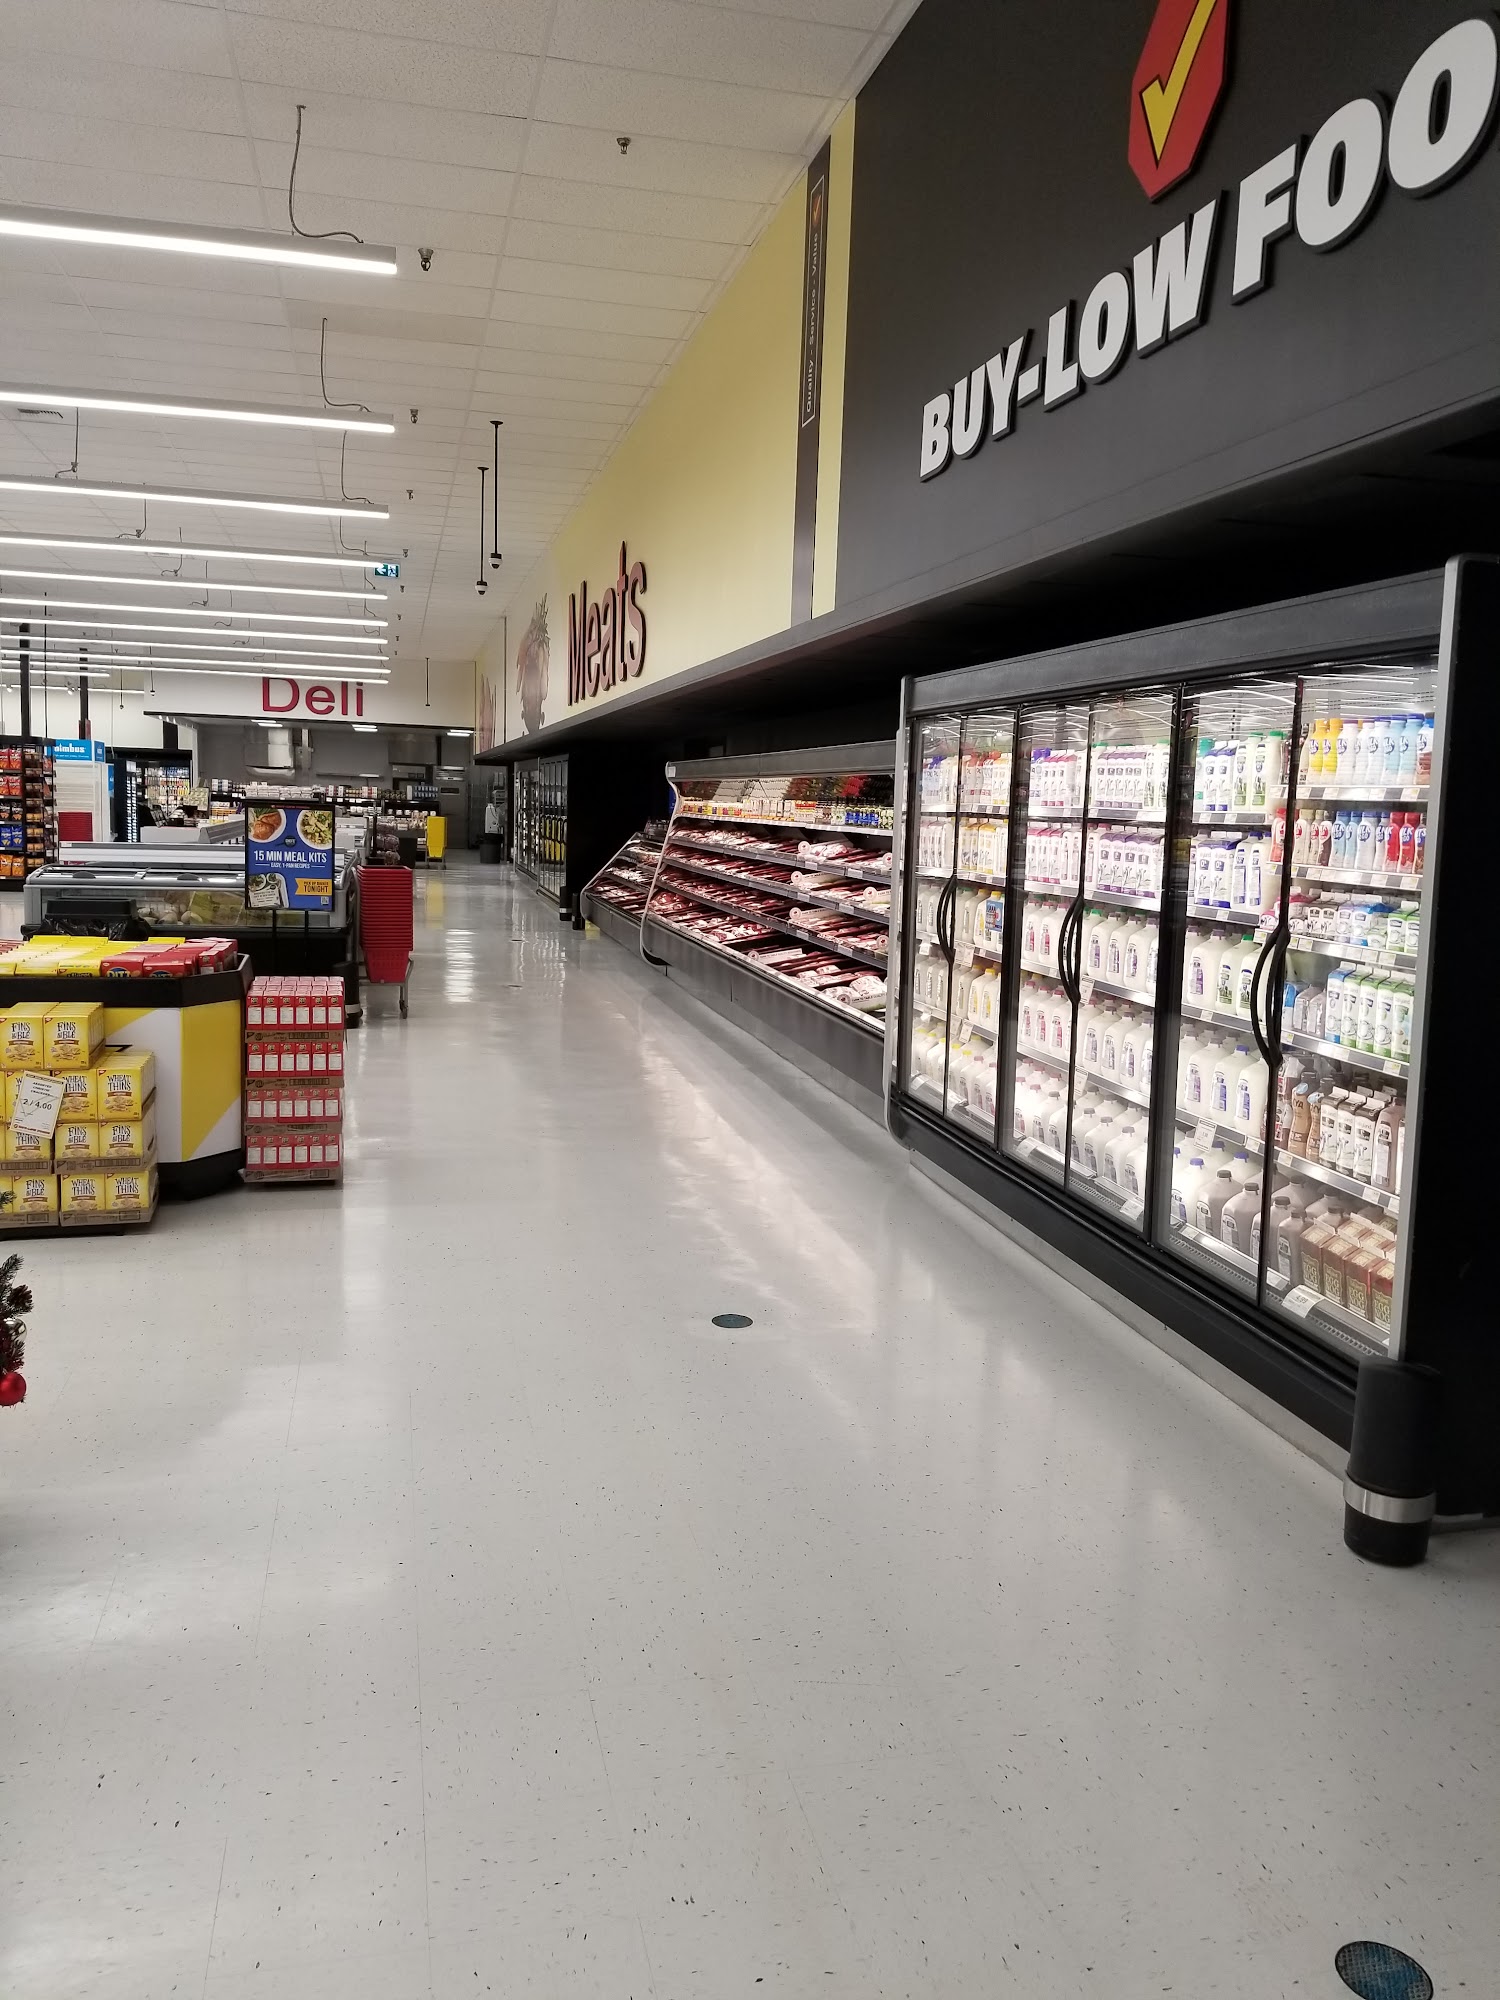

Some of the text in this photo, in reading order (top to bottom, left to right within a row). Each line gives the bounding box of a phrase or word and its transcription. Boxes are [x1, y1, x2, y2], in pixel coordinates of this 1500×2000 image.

[919, 18, 1498, 480] BUY-LOW FOO
[806, 359, 814, 412] Quality
[811, 232, 819, 276] Value
[568, 540, 648, 707] Meats
[262, 677, 364, 716] Deli
[254, 850, 327, 863] 15 MIN MEAL KITS
[107, 1074, 132, 1083] WHEAT
[64, 1081, 87, 1092] THINS
[107, 1081, 132, 1092] THINS
[71, 1178, 96, 1187] WHEAT
[115, 1177, 140, 1186] WHEAT
[72, 1185, 96, 1196] THINS
[116, 1184, 140, 1194] THINS
